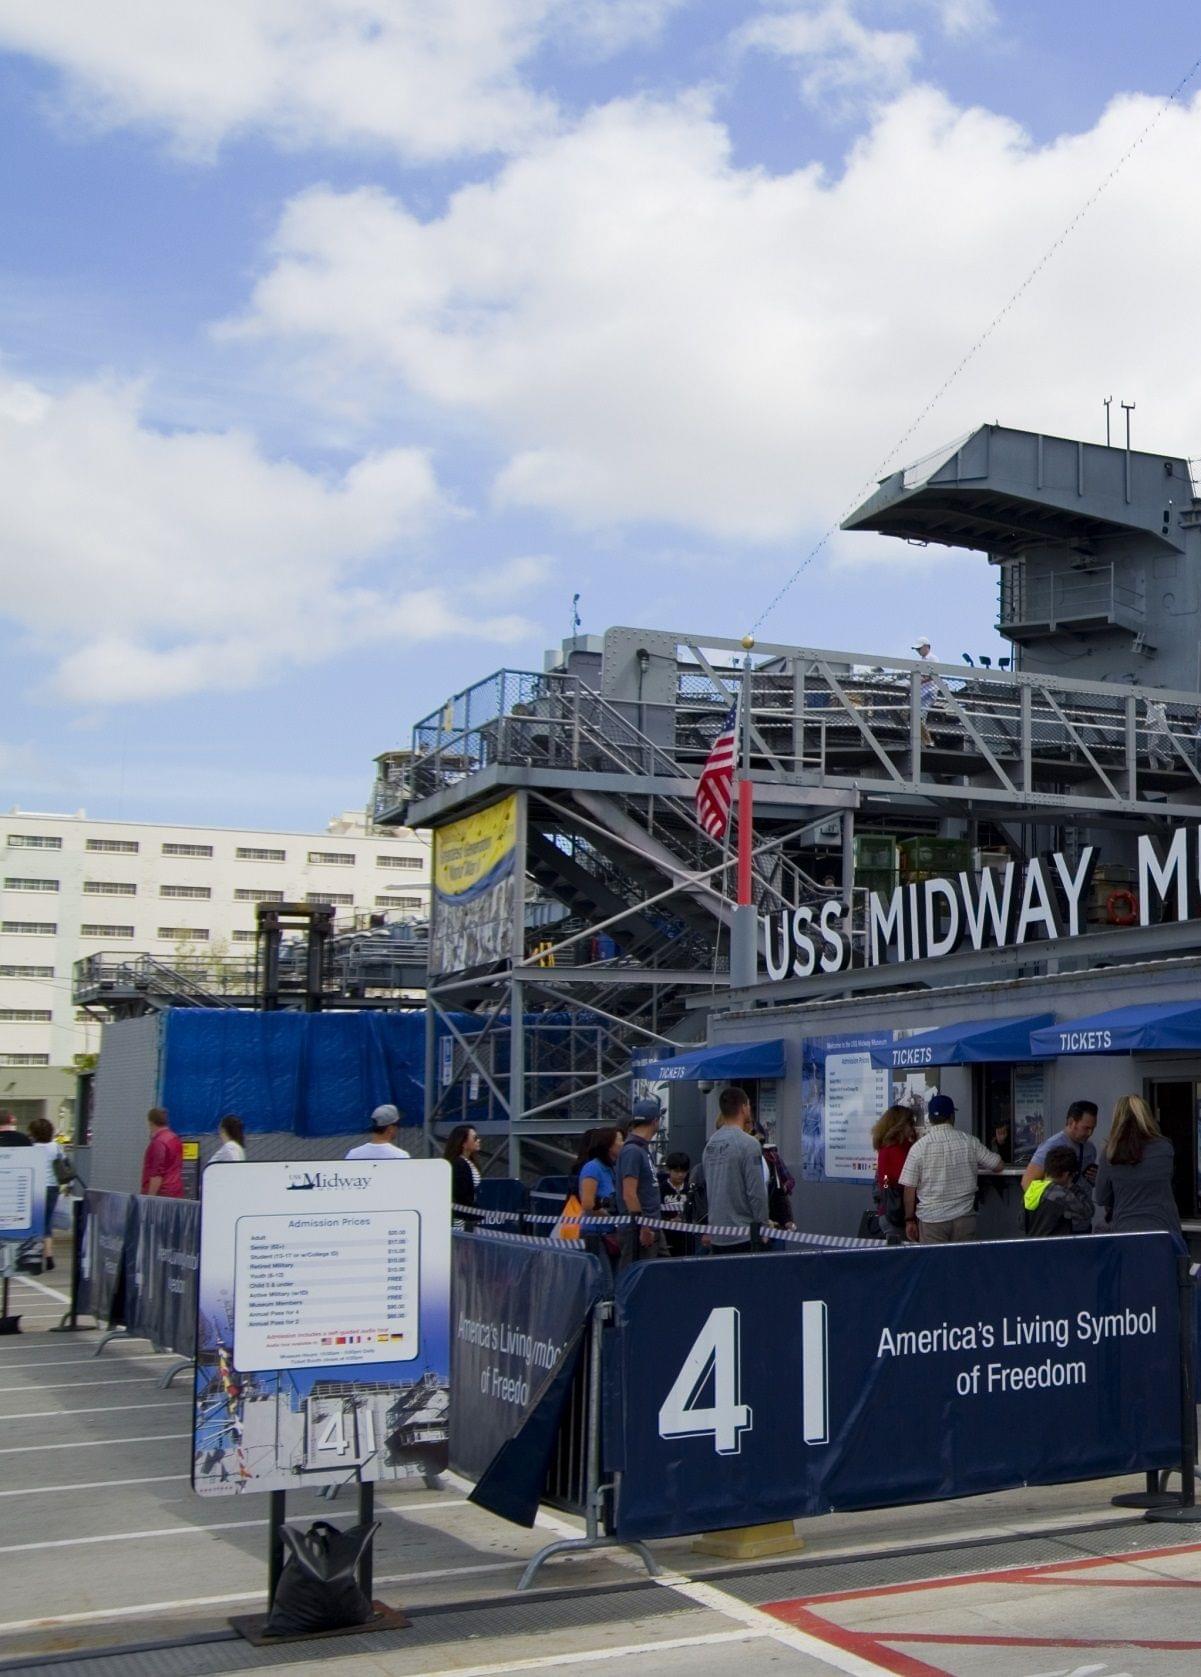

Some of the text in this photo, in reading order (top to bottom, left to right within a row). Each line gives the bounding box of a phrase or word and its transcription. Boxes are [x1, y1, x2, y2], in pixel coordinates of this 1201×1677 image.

[765, 900, 847, 981] USS
[870, 846, 1097, 965] MIDWAY
[1059, 1030, 1112, 1052] TICKETS
[892, 1047, 933, 1065] TICKETS
[659, 1067, 686, 1079] TICKETS
[303, 1172, 372, 1190] Midway
[288, 1218, 371, 1228] Admission Prices
[458, 1312, 498, 1350] America's
[500, 1323, 532, 1366] Living
[877, 1306, 1157, 1357] America's Living Symbol
[481, 1366, 490, 1395] of
[957, 1359, 1087, 1395] of Freedom
